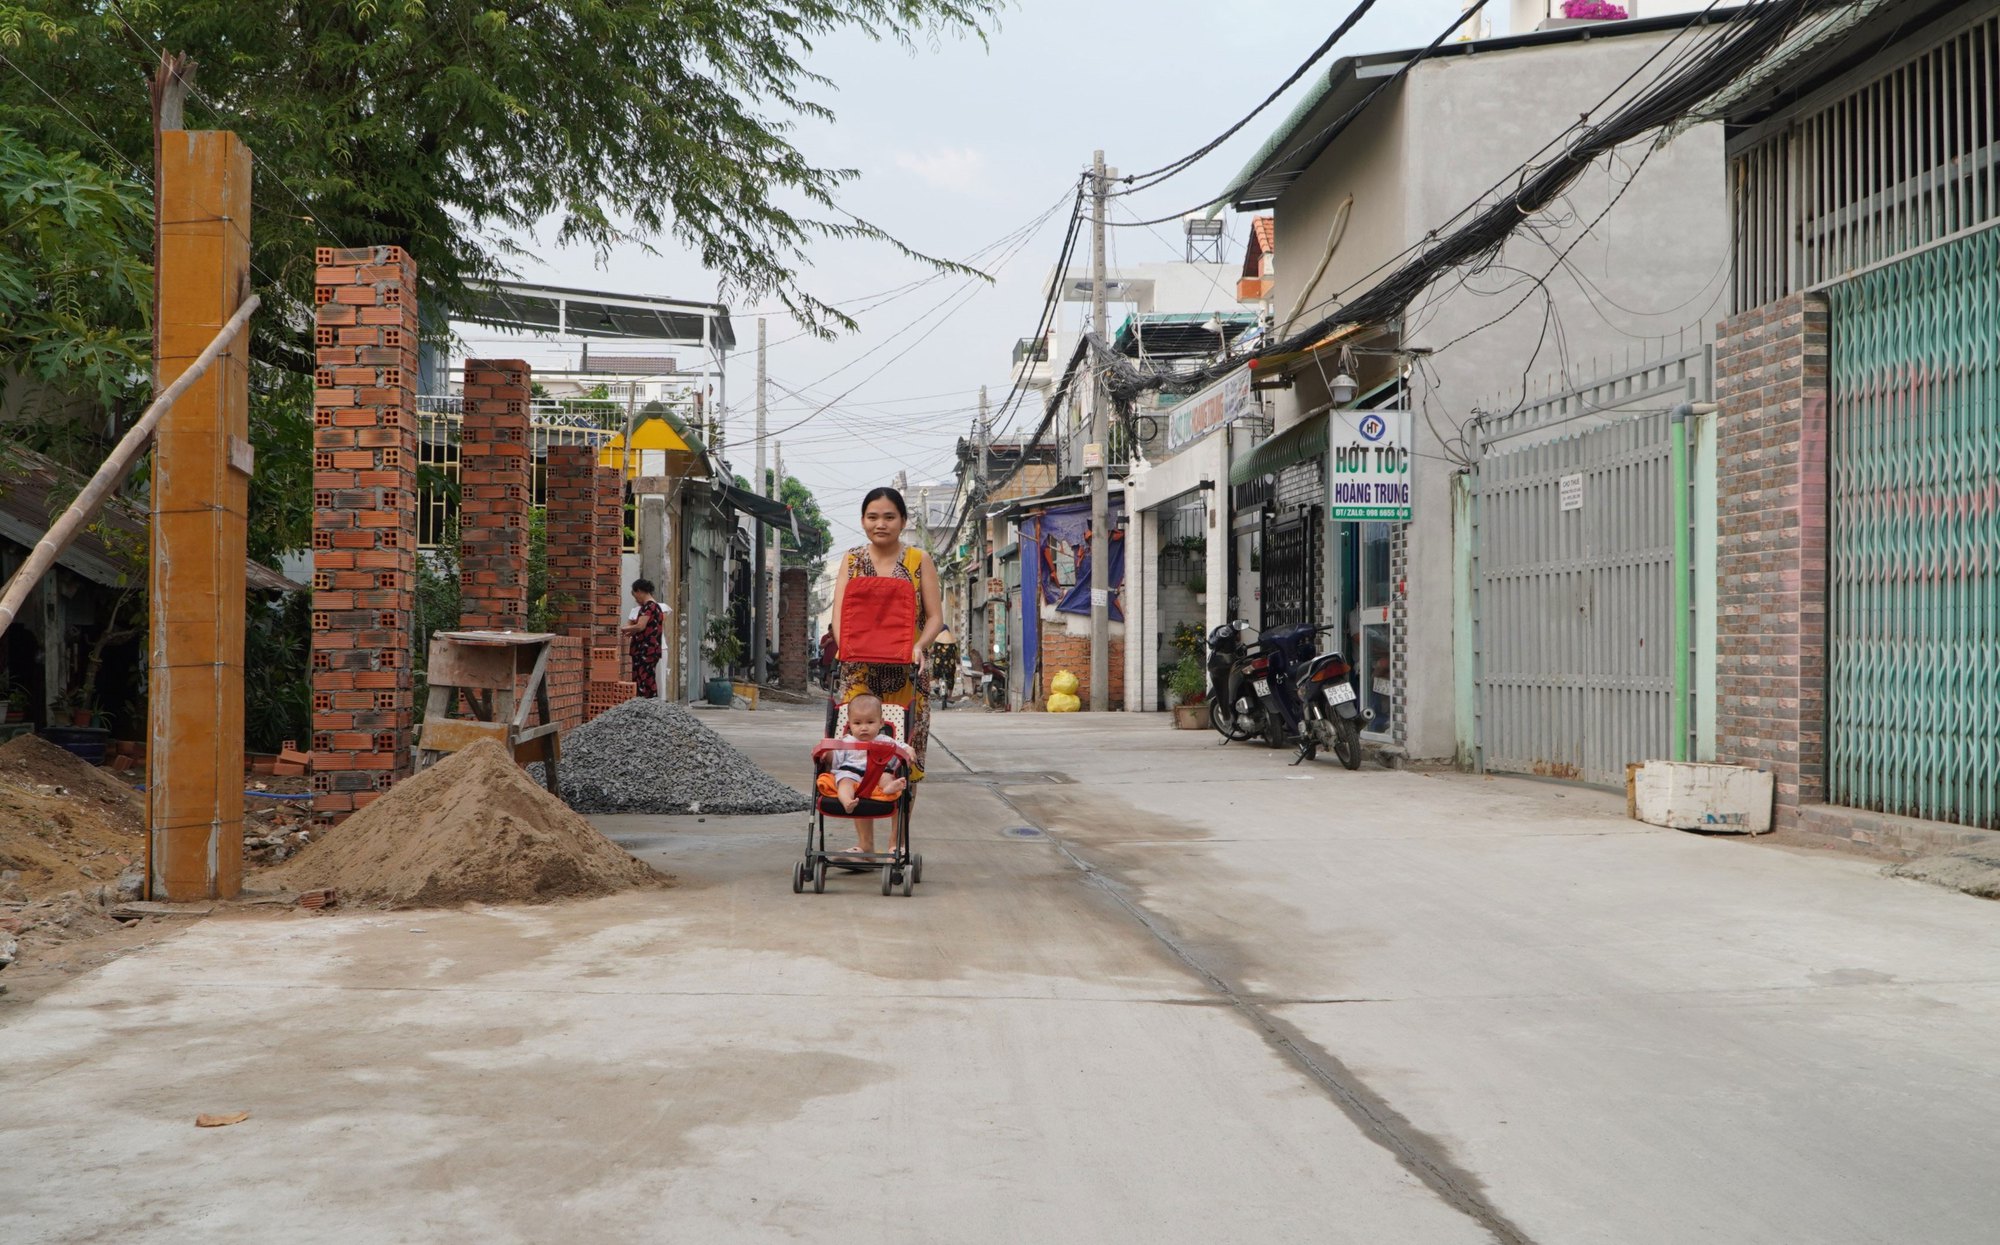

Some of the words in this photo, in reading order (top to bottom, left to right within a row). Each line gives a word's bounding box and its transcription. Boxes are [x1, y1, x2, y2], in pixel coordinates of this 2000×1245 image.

[1336, 441, 1369, 474] HỚT
[1375, 441, 1408, 474] TÓC
[1335, 479, 1371, 503] HOÀNG
[1374, 483, 1409, 504] TRUNG
